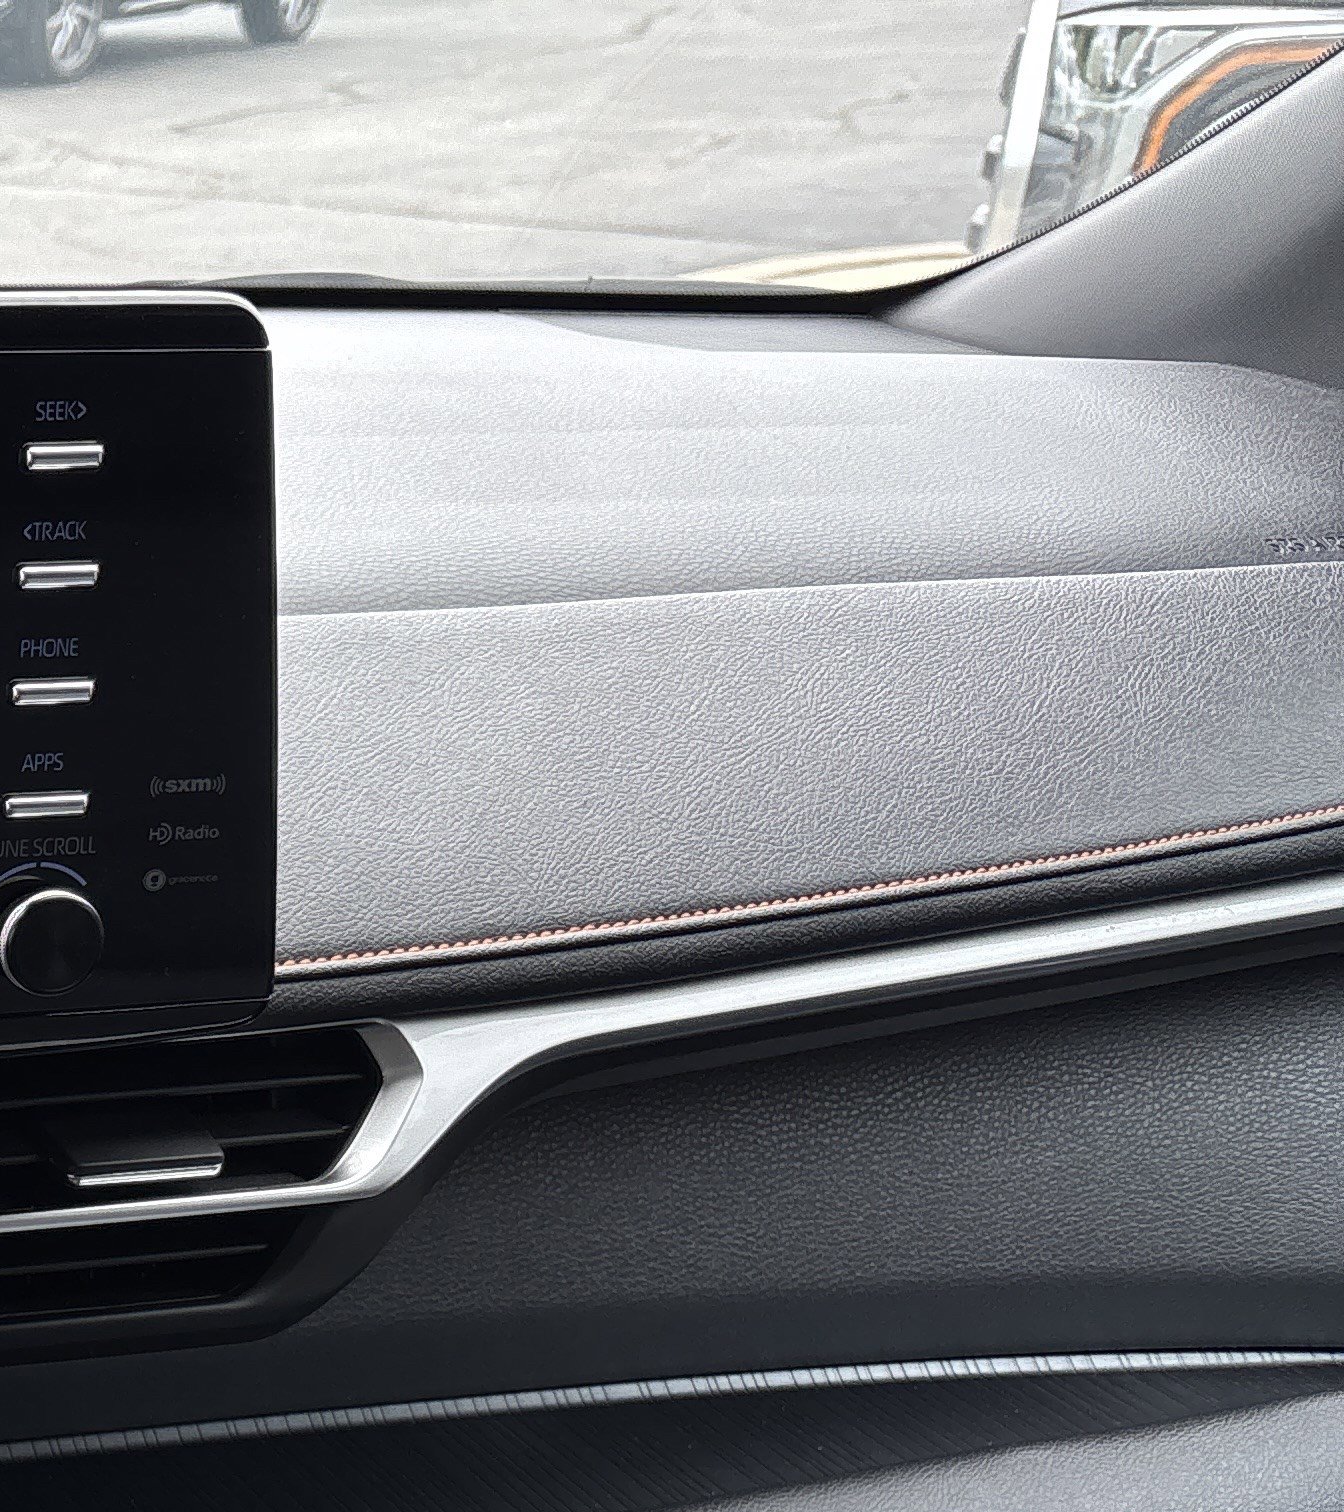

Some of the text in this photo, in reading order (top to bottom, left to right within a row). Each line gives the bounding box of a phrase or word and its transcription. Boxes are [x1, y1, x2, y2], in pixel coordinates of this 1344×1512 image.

[19, 638, 79, 658] PHONE
[21, 752, 65, 773] APPS
[175, 825, 220, 841] Radio
[32, 835, 96, 857] SCROLL
